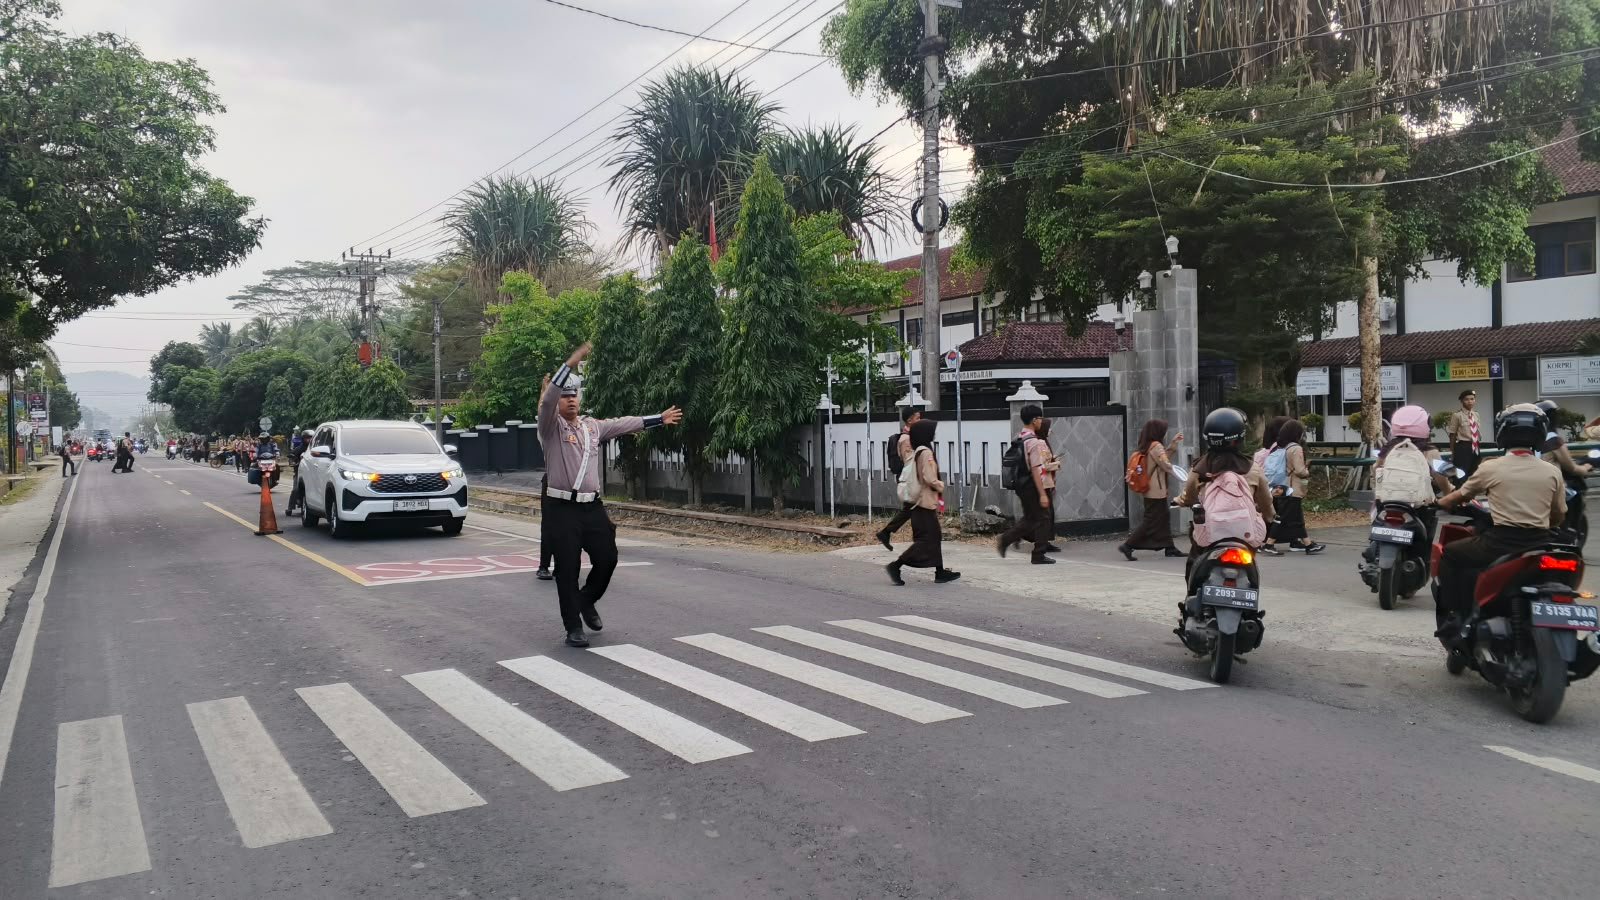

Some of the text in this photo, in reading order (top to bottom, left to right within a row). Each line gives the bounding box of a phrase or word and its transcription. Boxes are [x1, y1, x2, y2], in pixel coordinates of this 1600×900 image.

[1547, 362, 1572, 370] KORPRI
[1206, 587, 1211, 596] Z
[1215, 589, 1236, 598] 2093
[1535, 605, 1542, 616] Z
[1545, 605, 1571, 617] 5135
